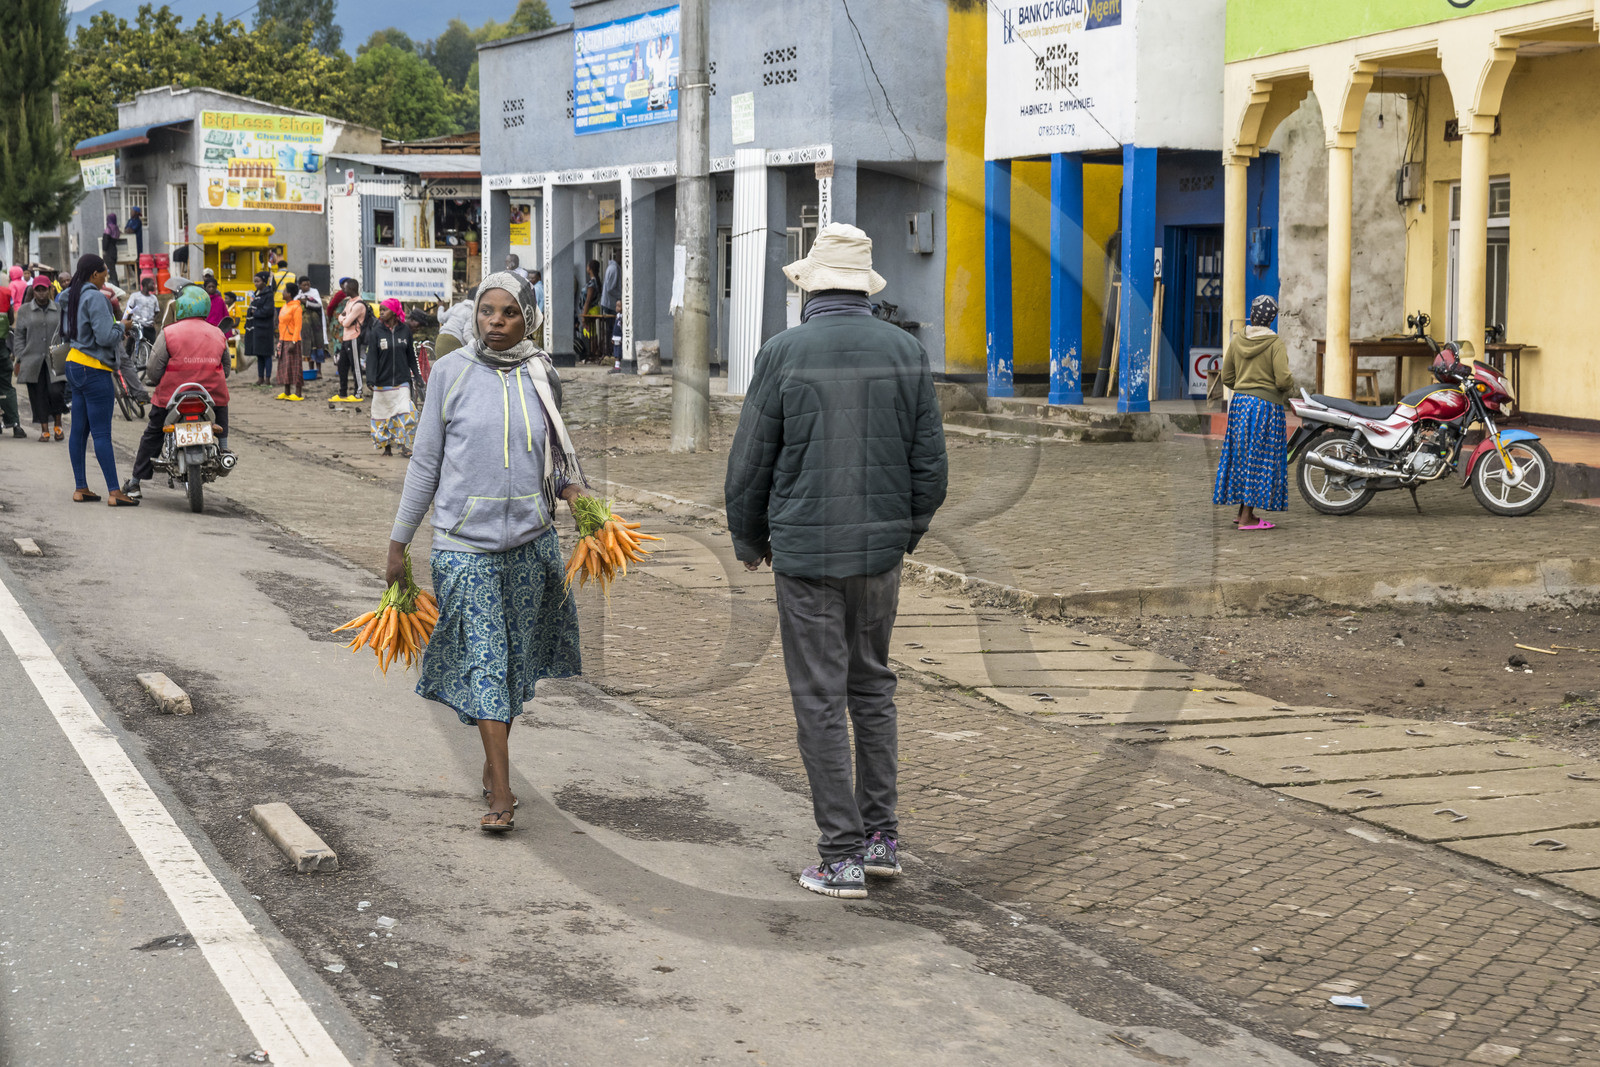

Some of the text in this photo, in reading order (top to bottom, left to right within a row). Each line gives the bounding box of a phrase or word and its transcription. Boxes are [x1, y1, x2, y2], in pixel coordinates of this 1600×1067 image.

[1019, 3, 1042, 25] BANK
[1043, 1, 1055, 20] OF
[1056, 0, 1083, 18] KIGALI
[1089, 0, 1120, 21] Agent
[1020, 97, 1095, 117] HABINEZA EMMANUEL
[203, 111, 323, 135] BigLess Shop
[256, 132, 321, 143] Chez Mugabe
